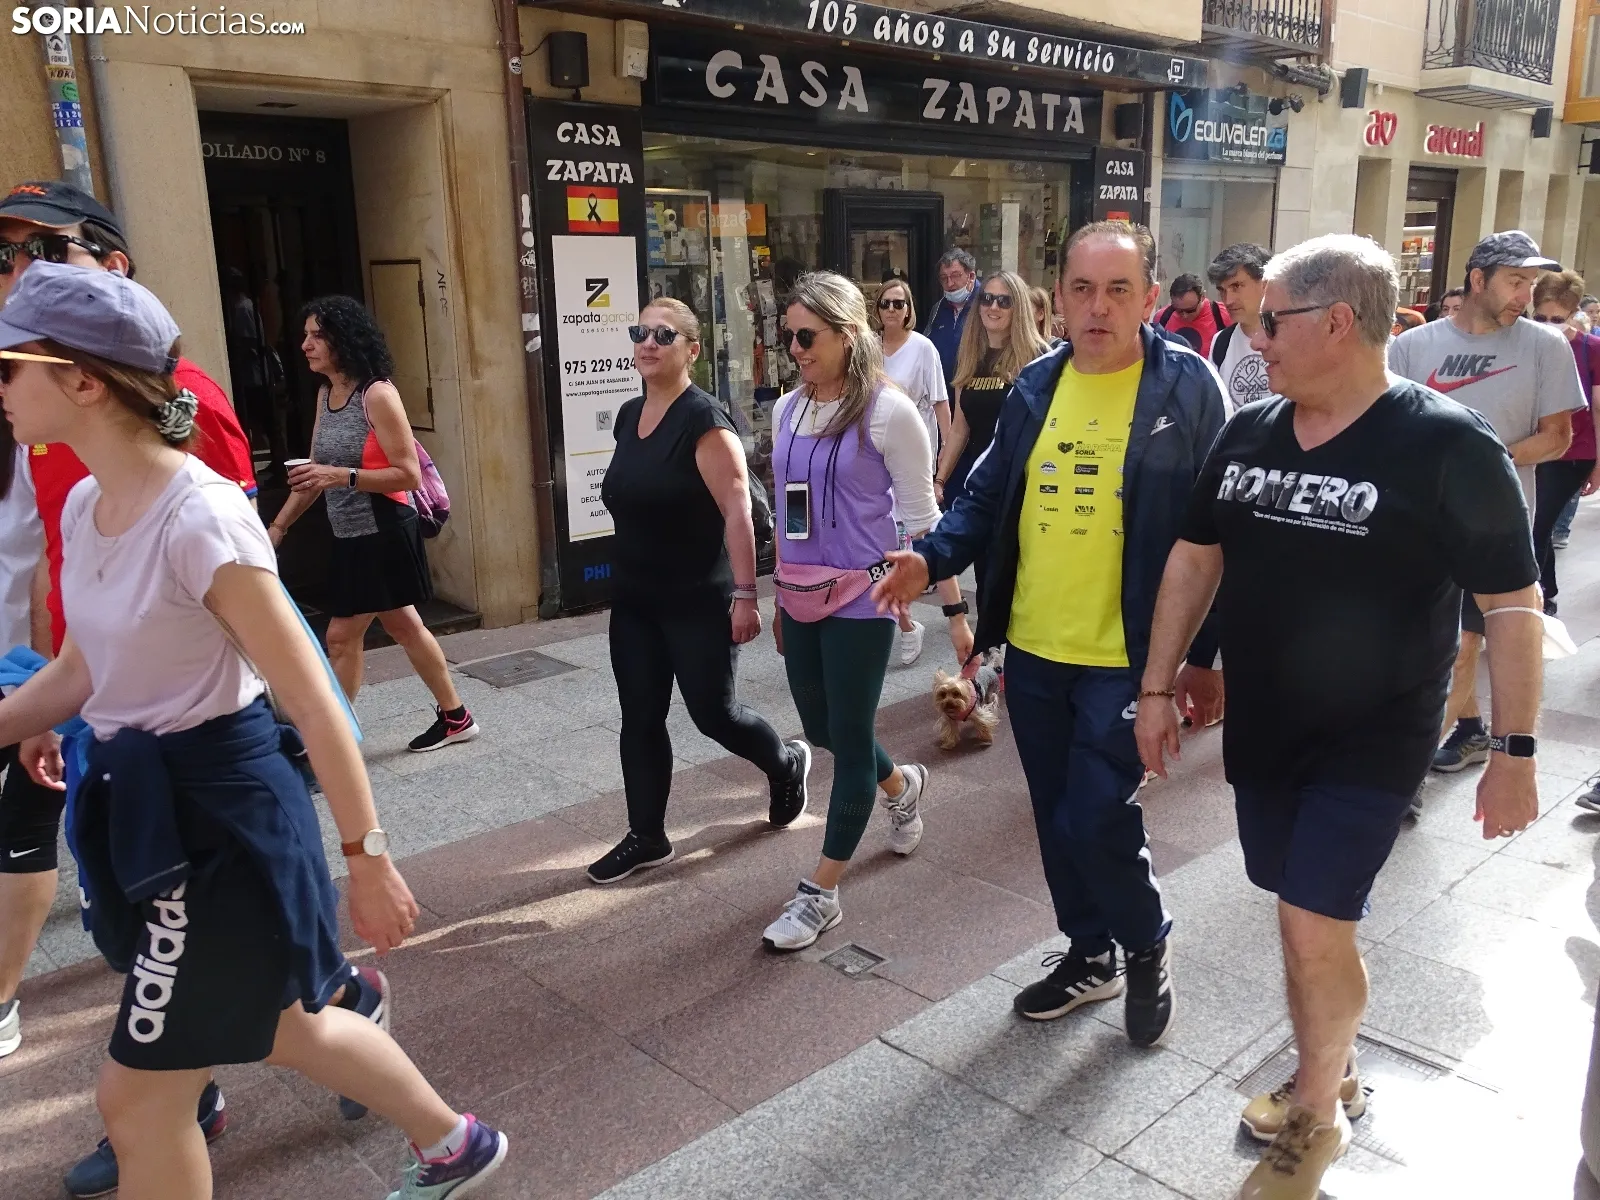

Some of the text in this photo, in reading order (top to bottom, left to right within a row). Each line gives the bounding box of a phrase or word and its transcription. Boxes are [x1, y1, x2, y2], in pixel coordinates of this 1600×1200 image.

[807, 0, 858, 35] 105
[873, 13, 945, 49] años
[959, 29, 974, 54] a
[705, 49, 1085, 134] CASA ZAPATA
[556, 121, 621, 147] CASA
[1424, 121, 1485, 158] arenal
[316, 150, 326, 163] 8
[1106, 160, 1135, 177] CASA
[546, 159, 634, 184] ZAPATA
[1100, 185, 1138, 201] ZAPATA
[564, 357, 636, 374] 975 229 424
[1438, 354, 1497, 377] NIKE
[1217, 461, 1379, 523] ROMERO
